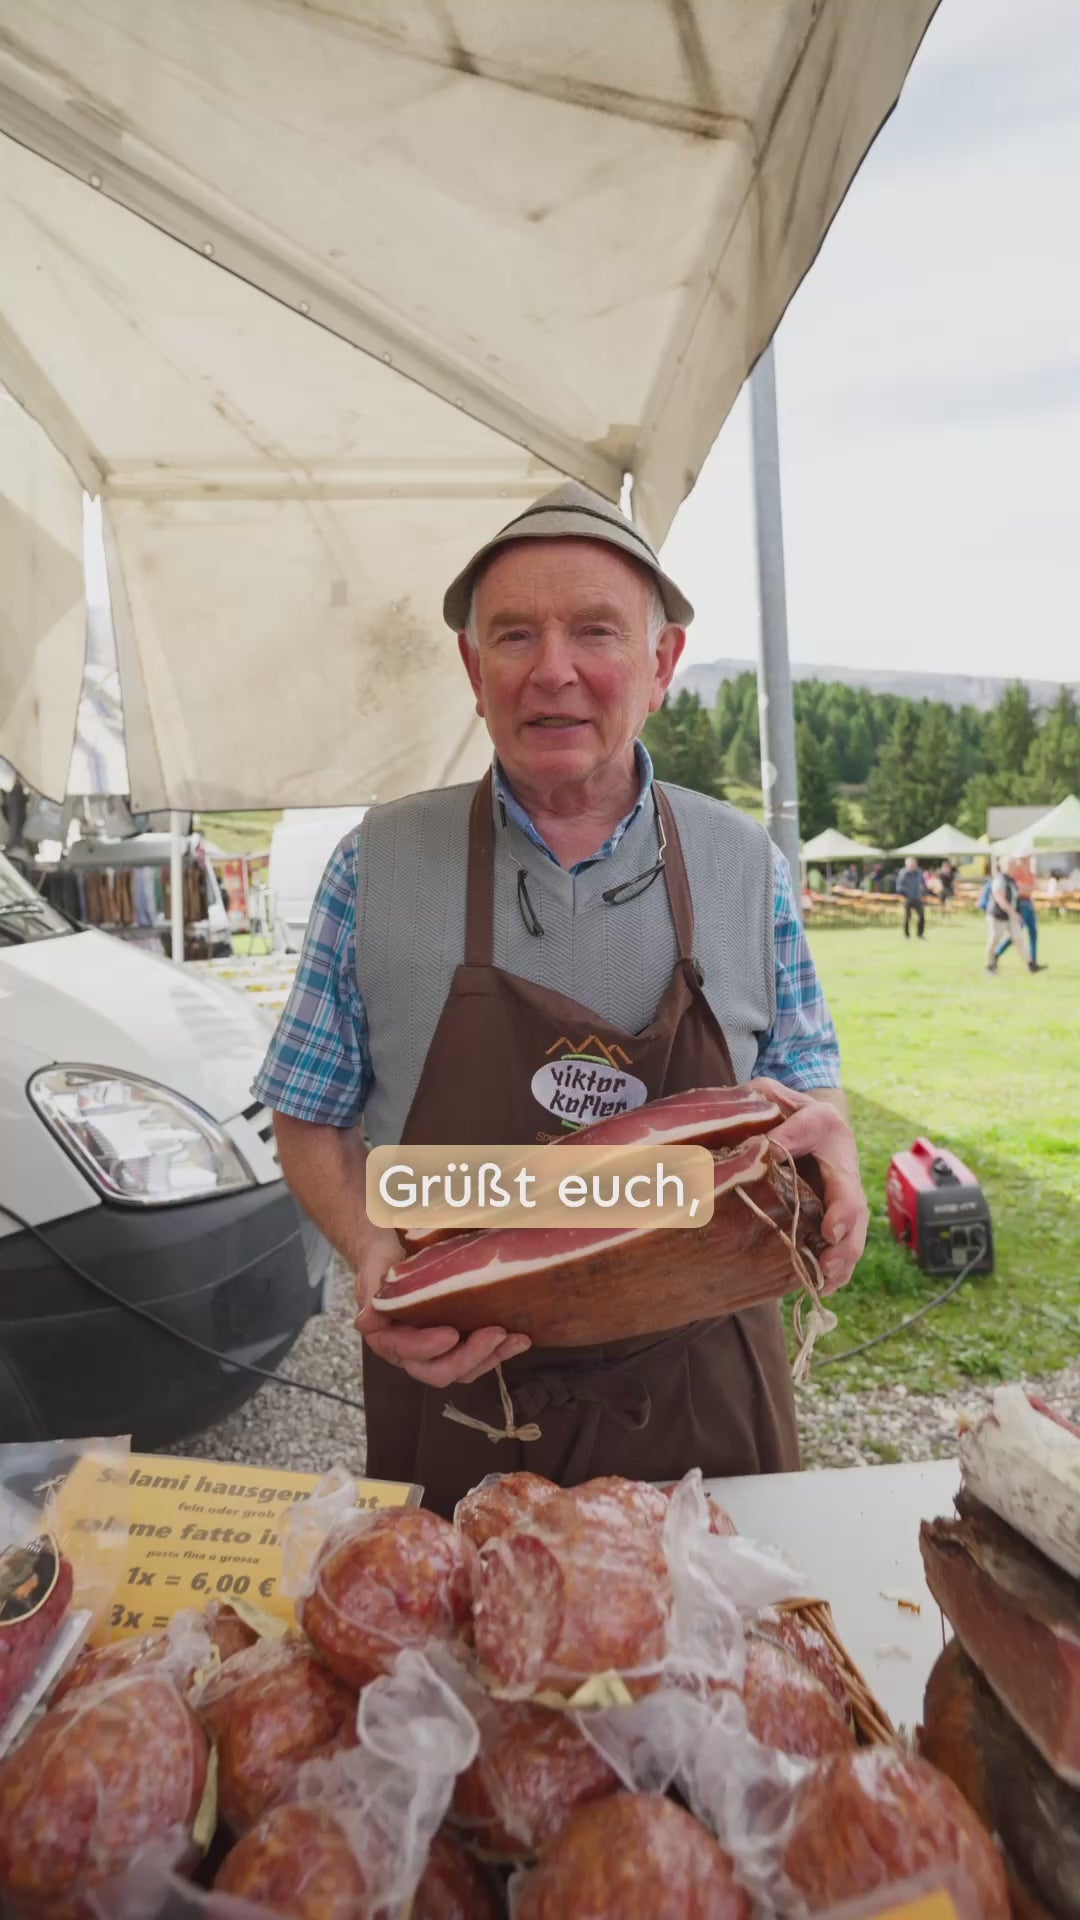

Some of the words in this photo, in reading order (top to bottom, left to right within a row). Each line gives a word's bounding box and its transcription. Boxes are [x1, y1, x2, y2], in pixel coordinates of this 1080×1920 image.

[550, 1090, 627, 1118] Kofler
[97, 1467, 190, 1491] Slami
[177, 1501, 205, 1513] fein
[207, 1505, 239, 1516] oder
[241, 1508, 276, 1520] grob
[180, 1522, 252, 1545] fatto
[182, 1550, 206, 1561] fina
[219, 1554, 260, 1565] grossa
[126, 1566, 157, 1586] 1x
[190, 1572, 250, 1595] 6,00
[258, 1577, 277, 1598] €
[111, 1603, 144, 1629] 3x
